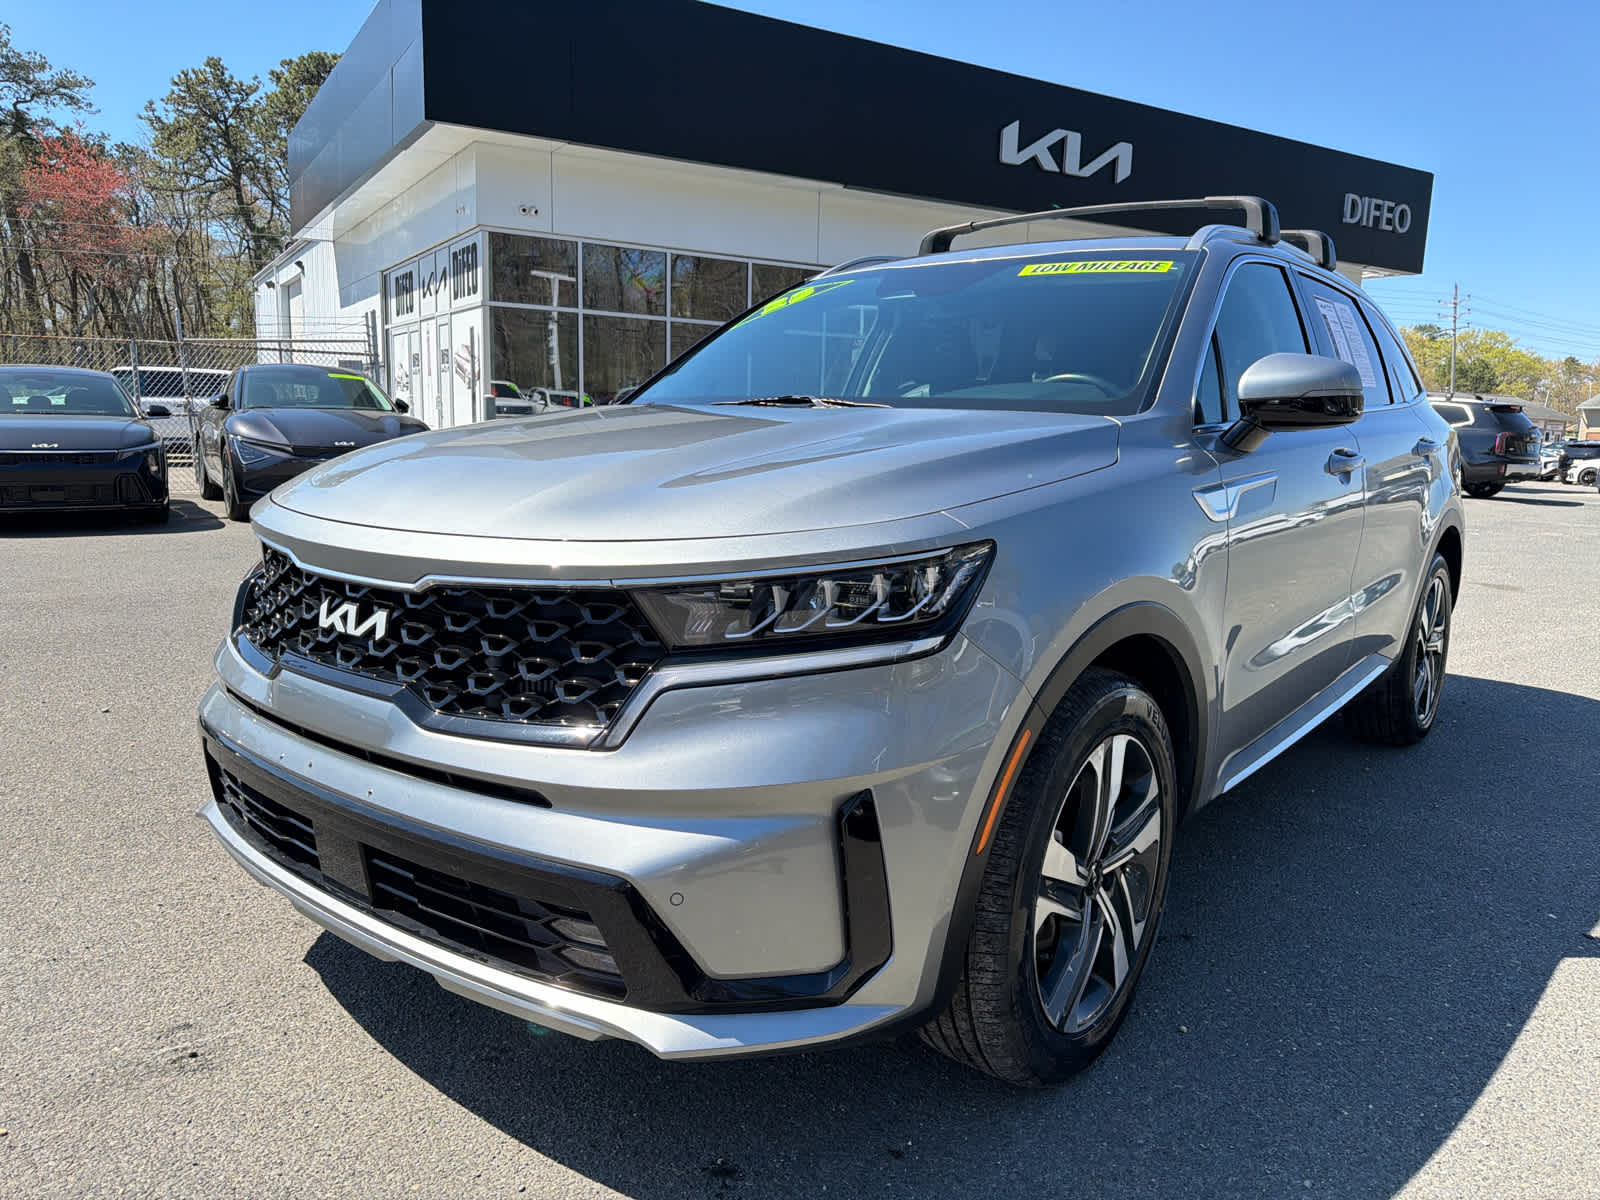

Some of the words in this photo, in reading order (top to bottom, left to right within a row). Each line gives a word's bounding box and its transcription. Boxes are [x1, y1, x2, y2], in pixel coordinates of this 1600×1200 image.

[1000, 120, 1133, 184] KIA
[1342, 193, 1411, 233] DIFEO
[1031, 264, 1071, 273] LOW
[1075, 262, 1162, 271] MILEAGE
[319, 597, 389, 641] KIA
